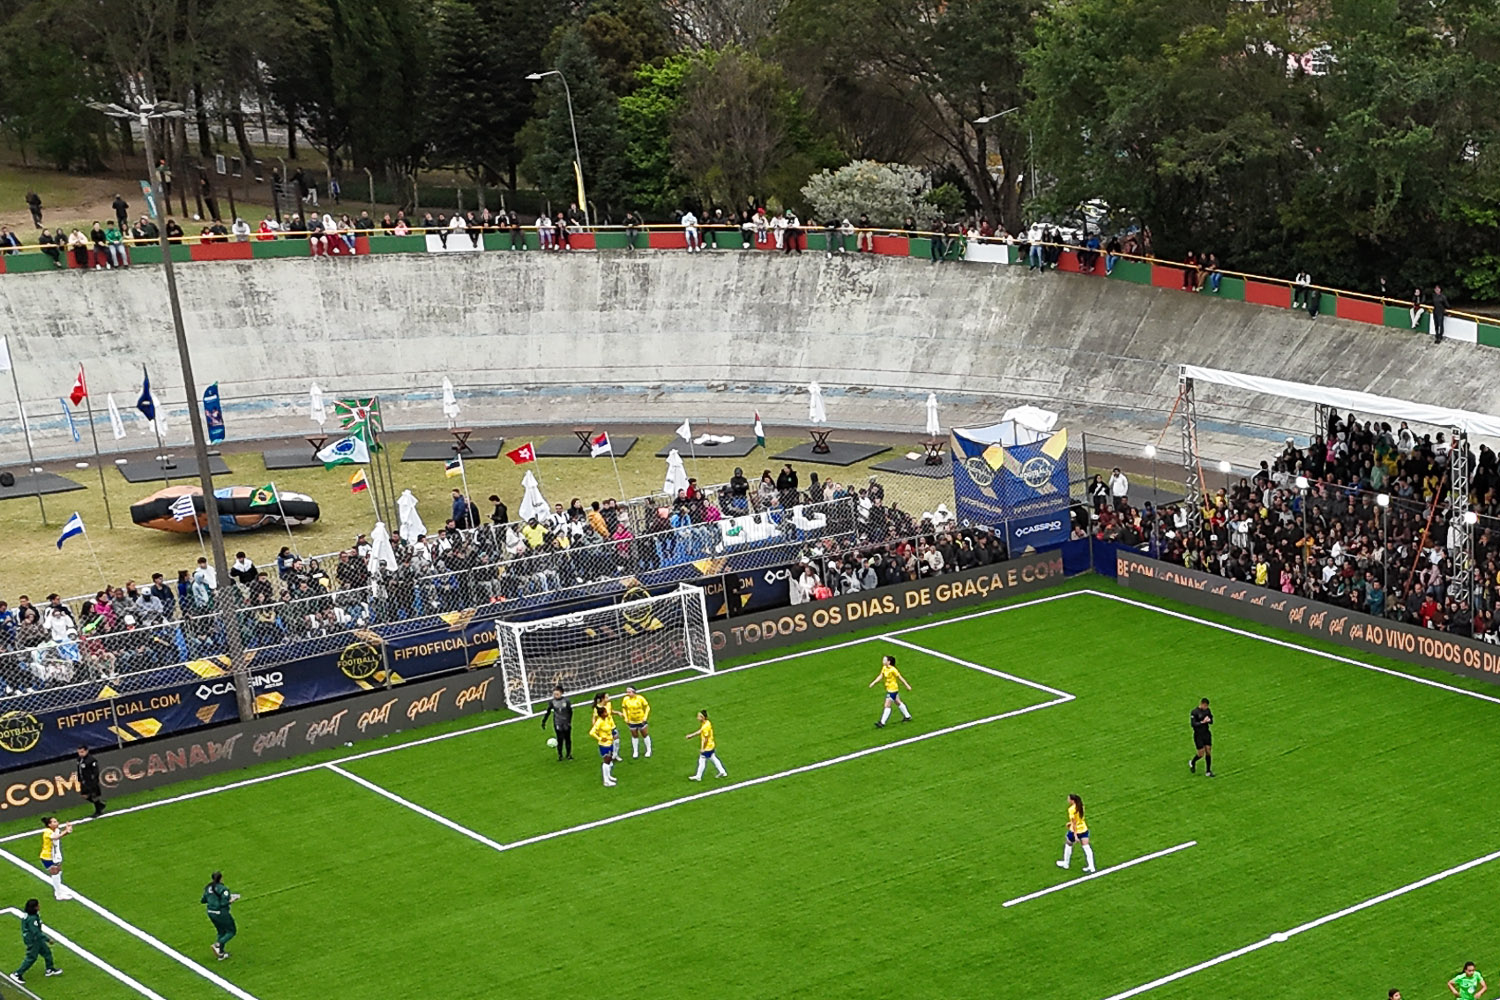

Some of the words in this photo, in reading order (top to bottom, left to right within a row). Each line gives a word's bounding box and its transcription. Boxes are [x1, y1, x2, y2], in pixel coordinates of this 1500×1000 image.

[1117, 558, 1129, 577] BE
[731, 614, 807, 646] TODOS
[812, 606, 842, 628] OS
[847, 595, 899, 621] DIAS,
[905, 588, 931, 609] DE
[935, 573, 1003, 601] GRAÇA
[1008, 568, 1018, 587] E
[1021, 558, 1064, 583] COM
[1365, 624, 1383, 645] AO
[1385, 629, 1415, 652] VIVO
[1417, 636, 1461, 664] TODOS
[1464, 648, 1481, 668] OS
[252, 721, 297, 756] GOAT
[305, 709, 348, 744] GOAT
[357, 698, 398, 733] GOAT
[406, 687, 447, 720] GOAT
[455, 677, 495, 709] GOAT
